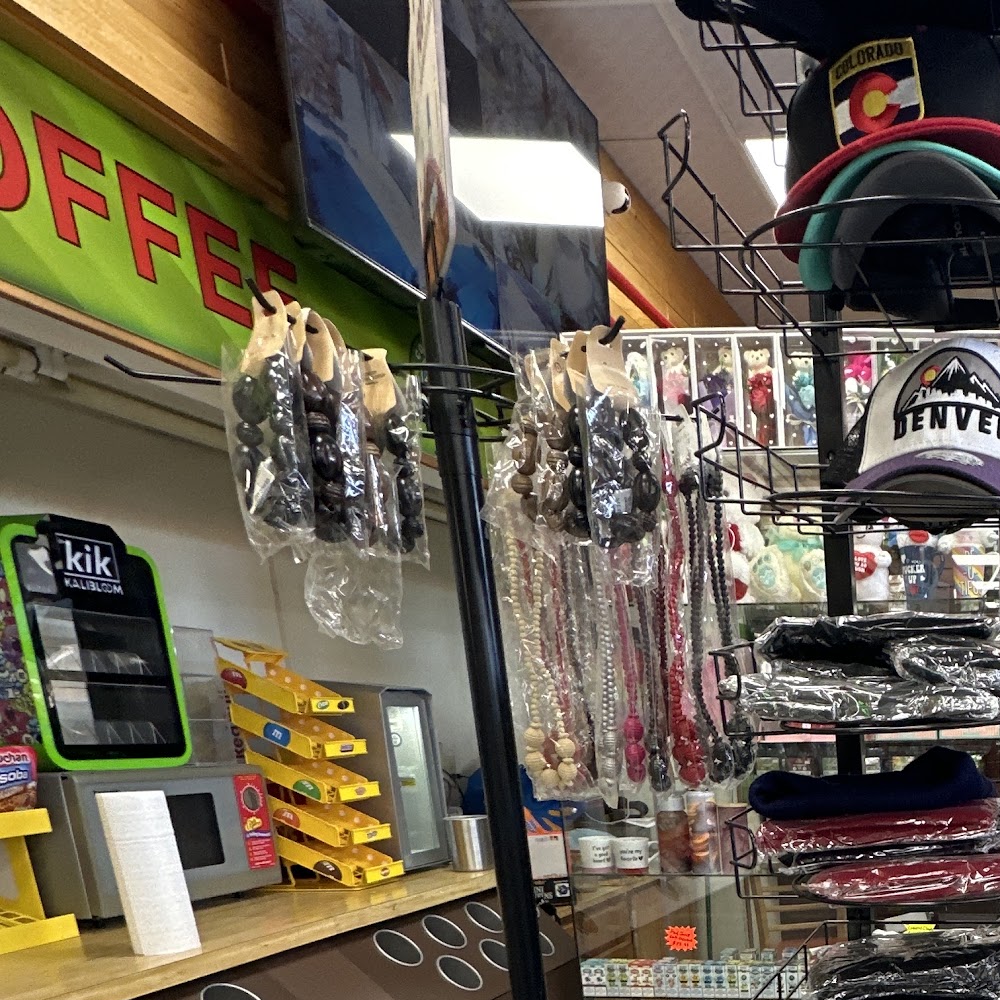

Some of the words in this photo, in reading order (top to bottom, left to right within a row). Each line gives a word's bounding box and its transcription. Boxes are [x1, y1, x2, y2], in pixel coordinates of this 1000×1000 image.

[835, 41, 904, 80] COLORADO
[63, 538, 114, 578] kik
[63, 577, 124, 596] KALIBLOOM
